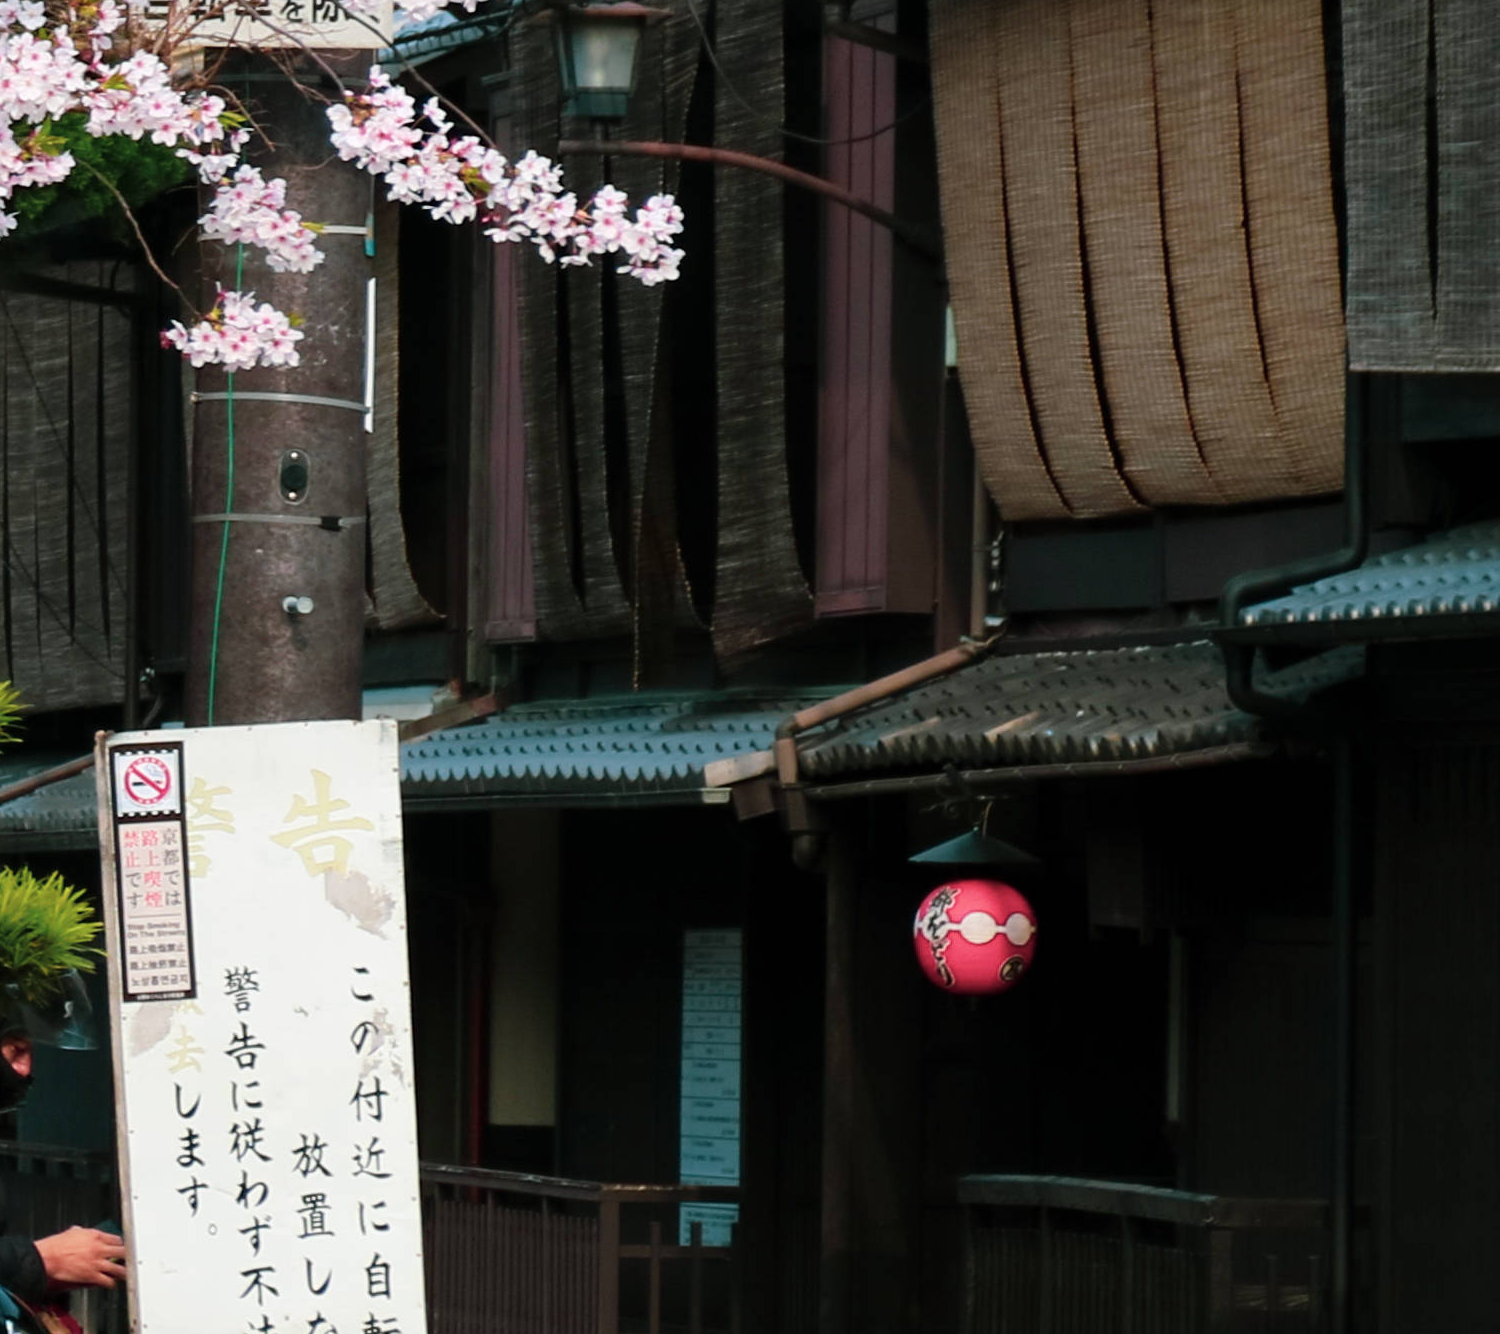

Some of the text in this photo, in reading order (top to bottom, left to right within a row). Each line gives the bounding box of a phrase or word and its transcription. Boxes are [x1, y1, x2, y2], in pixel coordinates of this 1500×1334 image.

[123, 830, 143, 908] 禁止です
[141, 829, 164, 908] 路上喫煙
[162, 828, 182, 907] 京都では
[140, 930, 155, 938] The
[147, 922, 181, 930] Smoking
[164, 1001, 218, 1236] 去します。
